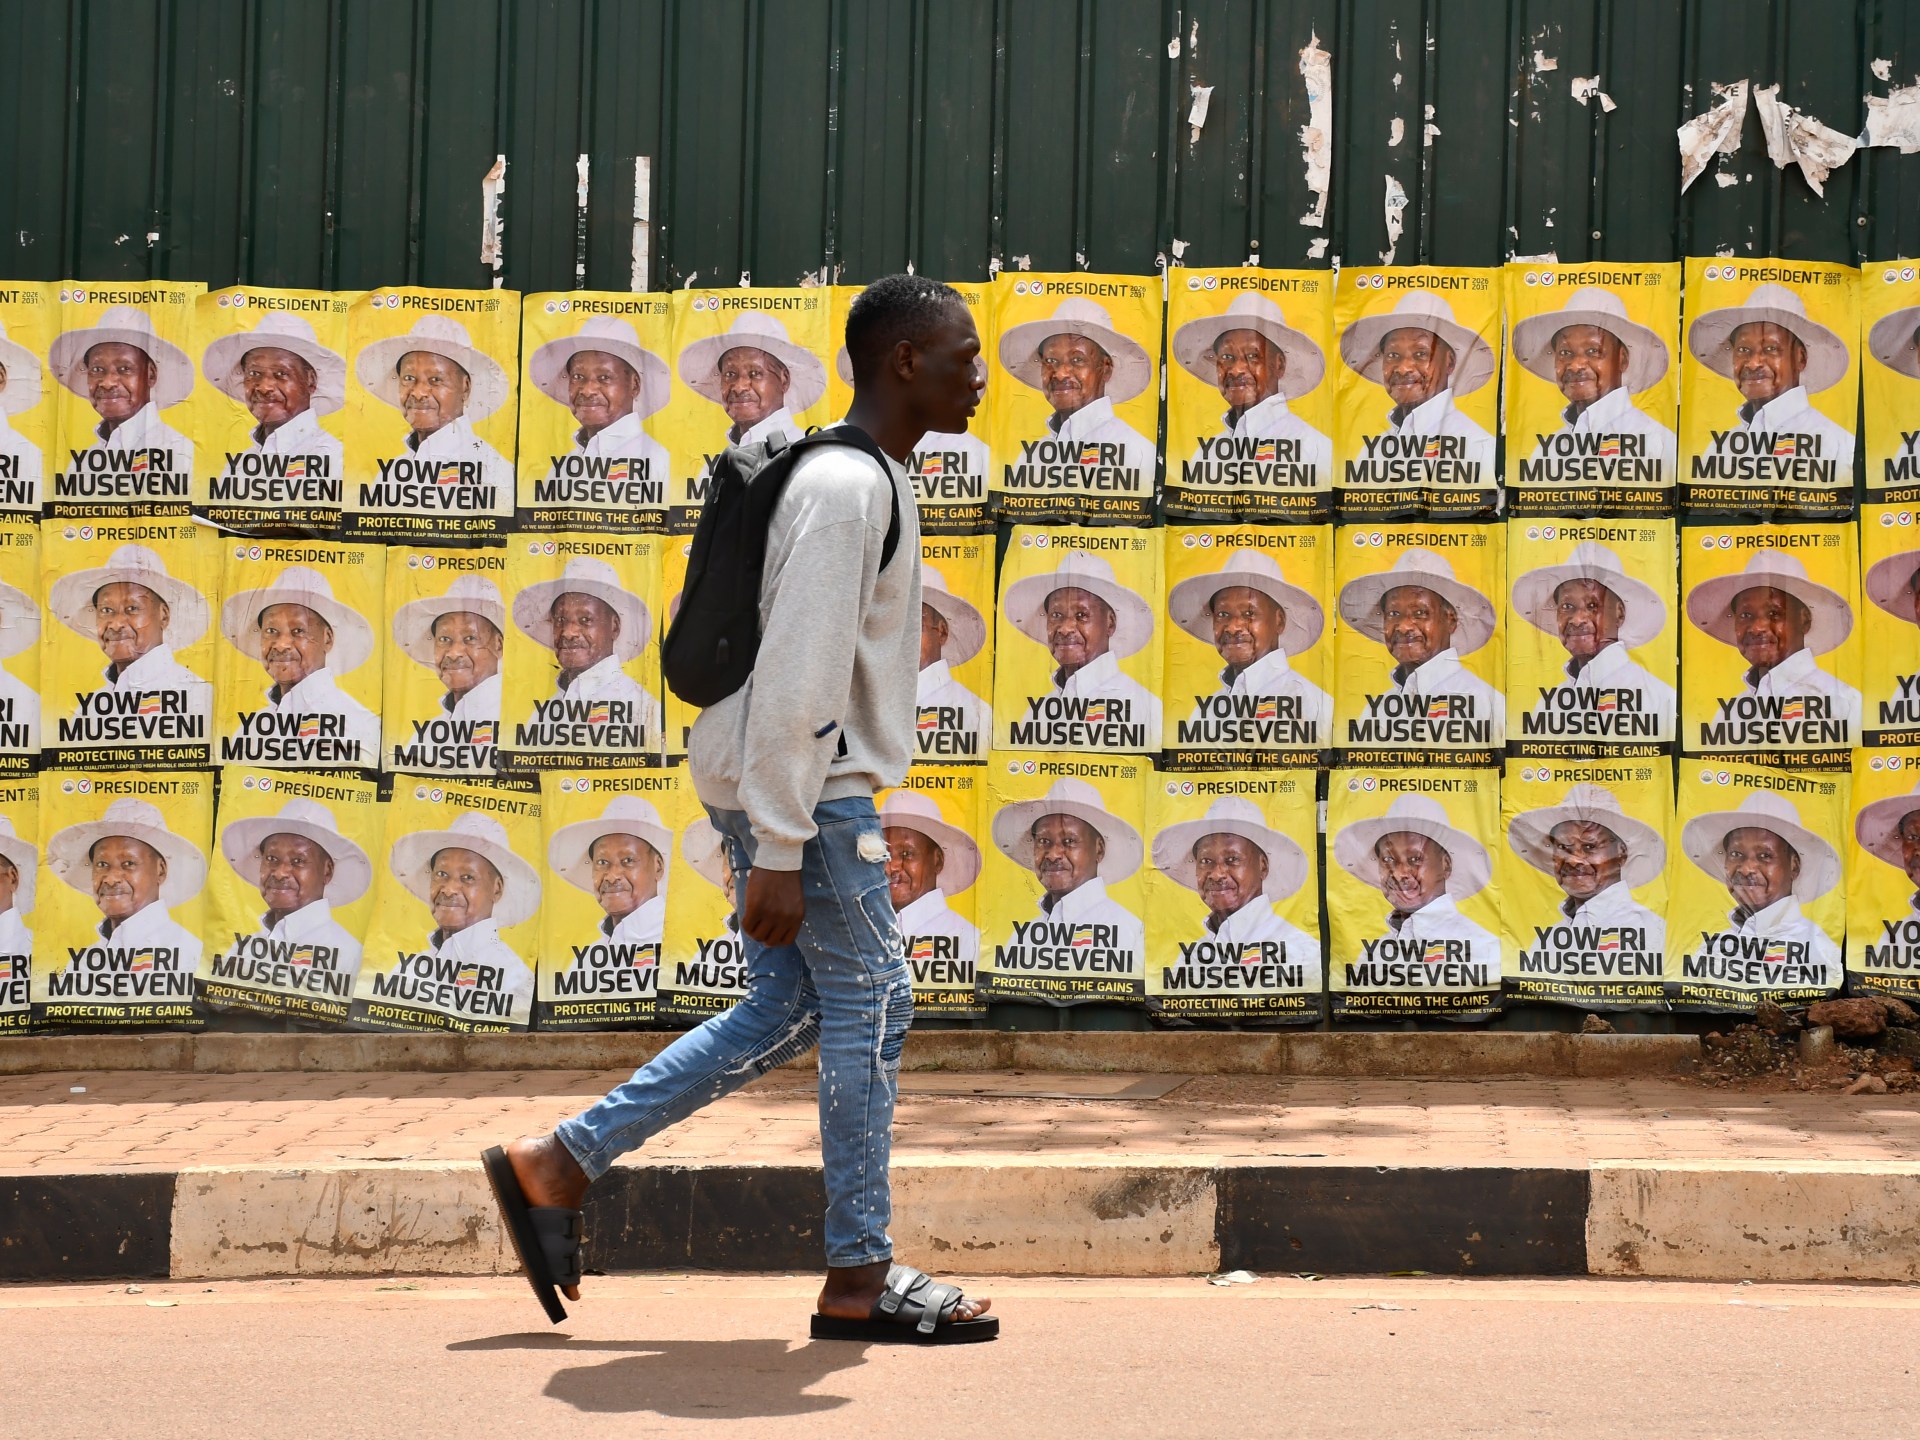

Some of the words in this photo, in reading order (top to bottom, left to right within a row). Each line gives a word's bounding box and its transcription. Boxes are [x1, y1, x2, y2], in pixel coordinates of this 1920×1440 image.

[1387, 275, 1469, 289] PRESIDENT
[1558, 272, 1642, 285] PRESIDENT
[1739, 268, 1821, 284] PRESIDENT
[1046, 282, 1127, 296] PRESIDENT
[1220, 277, 1298, 292] PRESIDENT
[89, 290, 167, 304] PRESIDENT
[248, 297, 330, 312] PRESIDENT
[402, 296, 484, 313] PRESIDENT
[722, 296, 801, 310] PRESIDENT
[572, 300, 652, 314] PRESIDENT
[904, 451, 967, 475] WERI
[1519, 458, 1661, 481] MUSEVENI
[1691, 455, 1836, 482] MUSEVENI
[1003, 464, 1138, 490] MUSEVENI
[1180, 461, 1315, 487] MUSEVENI
[1346, 459, 1479, 483] MUSEVENI
[55, 473, 187, 496] MUSEVENI
[208, 478, 344, 502] MUSEVENI
[534, 479, 663, 505] MUSEVENI
[359, 484, 497, 511] MUSEVENI
[1002, 497, 1074, 507] PROTECTING
[1079, 498, 1099, 510] THE
[1103, 500, 1139, 510] GAINS
[1518, 491, 1596, 501] PROTECTING
[1600, 490, 1622, 501] THE
[1625, 491, 1662, 502] GAINS
[53, 505, 127, 514] PROTECTING
[131, 505, 150, 514] THE
[153, 505, 189, 513] GAINS
[534, 510, 601, 521] PROTECTING
[606, 513, 628, 523] THE
[632, 513, 661, 523] GAINS
[922, 508, 945, 518] THE
[949, 506, 983, 518] GAINS
[358, 516, 432, 528] PROTECTING
[437, 519, 460, 530] THE
[464, 519, 494, 530] GAINS
[97, 526, 176, 540] PRESIDENT
[1386, 532, 1467, 546] PRESIDENT
[1560, 527, 1635, 541] PRESIDENT
[1051, 535, 1127, 550] PRESIDENT
[1216, 534, 1296, 548] PRESIDENT
[1736, 534, 1819, 548] PRESIDENT
[265, 548, 345, 564] PRESIDENT
[557, 542, 634, 556] PRESIDENT
[438, 556, 507, 570] PRESIDEN
[58, 715, 203, 741] MUSEVENI
[1348, 719, 1490, 743] MUSEVENI
[1523, 711, 1657, 736] MUSEVENI
[412, 720, 499, 744] YOWE
[515, 723, 645, 748] MUSEVENI
[1010, 721, 1145, 747] MUSEVENI
[1178, 720, 1316, 743] MUSEVENI
[1700, 720, 1848, 745] MUSEVENI
[219, 737, 360, 761] MUSEVENI
[916, 731, 977, 754] VENI
[1522, 743, 1596, 754] PROTECTING
[1597, 745, 1619, 755] THE
[1622, 746, 1660, 754] GAINS
[59, 750, 135, 762] PROTECTING
[139, 749, 163, 759] THE
[167, 748, 205, 759] GAINS
[1177, 752, 1252, 762] PROTECTING
[1255, 753, 1278, 763] THE
[1282, 753, 1318, 763] GAINS
[1039, 762, 1117, 777] PRESIDENT
[1554, 768, 1631, 782] PRESIDENT
[93, 780, 178, 794] PRESIDENT
[592, 777, 671, 792] PRESIDENT
[901, 776, 955, 789] SIDENT
[1197, 780, 1276, 794] PRESIDENT
[1379, 778, 1461, 792] PRESIDENT
[1733, 774, 1816, 793] PRESIDENT
[274, 781, 354, 802] PRESIDENT
[443, 792, 527, 814] PRESIDENT
[572, 944, 661, 969] YOWE
[994, 946, 1132, 973] MUSEVENI
[1517, 951, 1662, 976] MUSEVENI
[210, 954, 350, 997] MUSEVENI
[911, 960, 974, 984] VENI
[1162, 965, 1302, 989] MUSEVENI
[1344, 963, 1487, 987] MUSEVENI
[1682, 956, 1826, 989] MUSEVENI
[48, 972, 194, 996] MUSEVENI
[373, 972, 514, 1018] MUSEVENI
[912, 992, 935, 1003] THE
[938, 993, 974, 1003] GAINS
[1162, 998, 1237, 1008] PROTECTING
[1242, 997, 1265, 1007] THE
[1268, 996, 1305, 1007] GAINS
[45, 1005, 124, 1016] PROTECTING
[129, 1005, 152, 1016] THE
[155, 1005, 192, 1015] GAINS
[554, 1002, 630, 1015] PROTECTING
